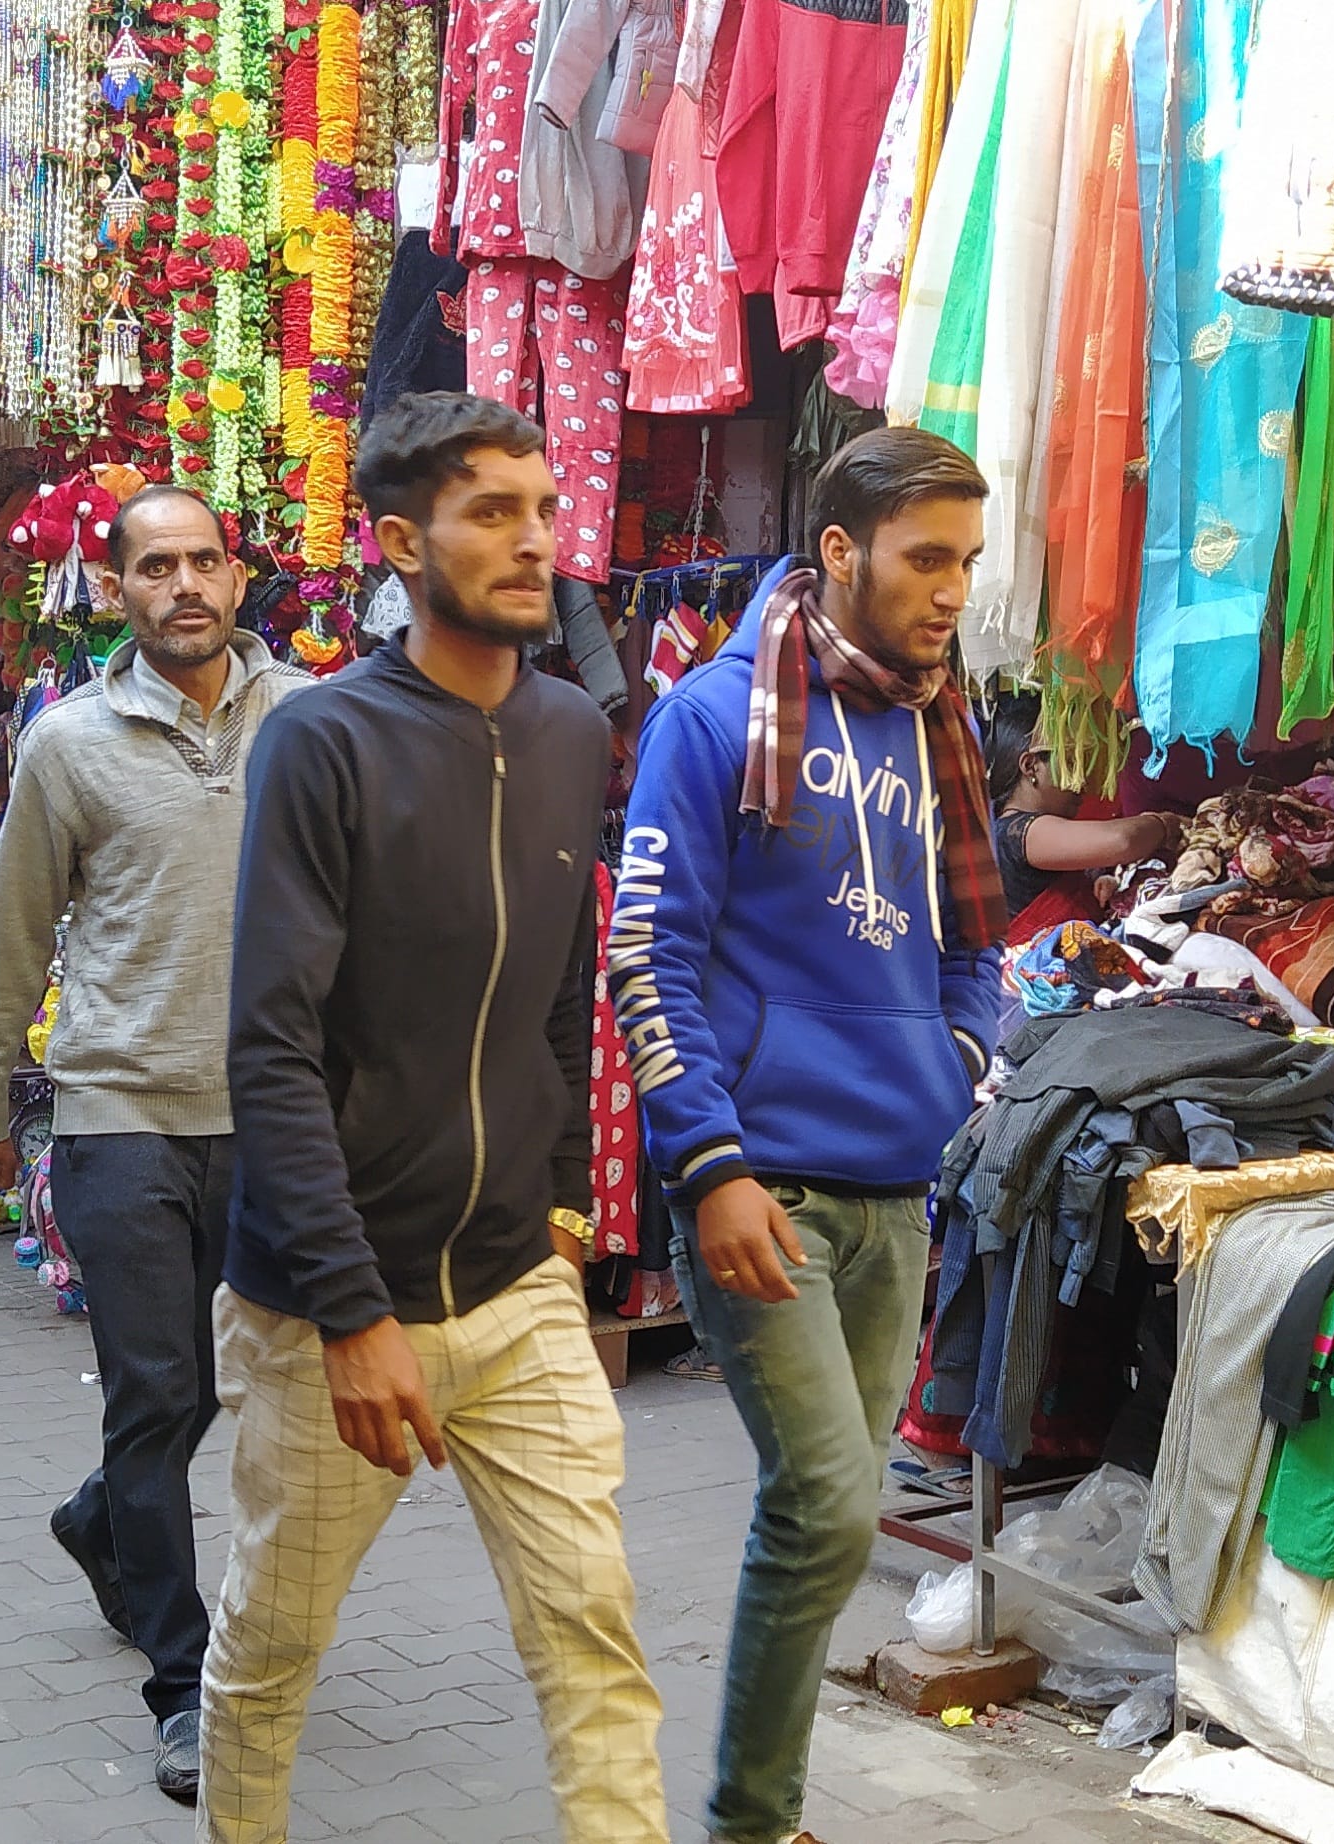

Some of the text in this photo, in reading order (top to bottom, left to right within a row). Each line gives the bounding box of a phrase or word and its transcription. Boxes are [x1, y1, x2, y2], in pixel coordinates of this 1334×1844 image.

[801, 747, 913, 828] alvin
[826, 870, 912, 936] Jeans
[846, 916, 894, 951] 1968
